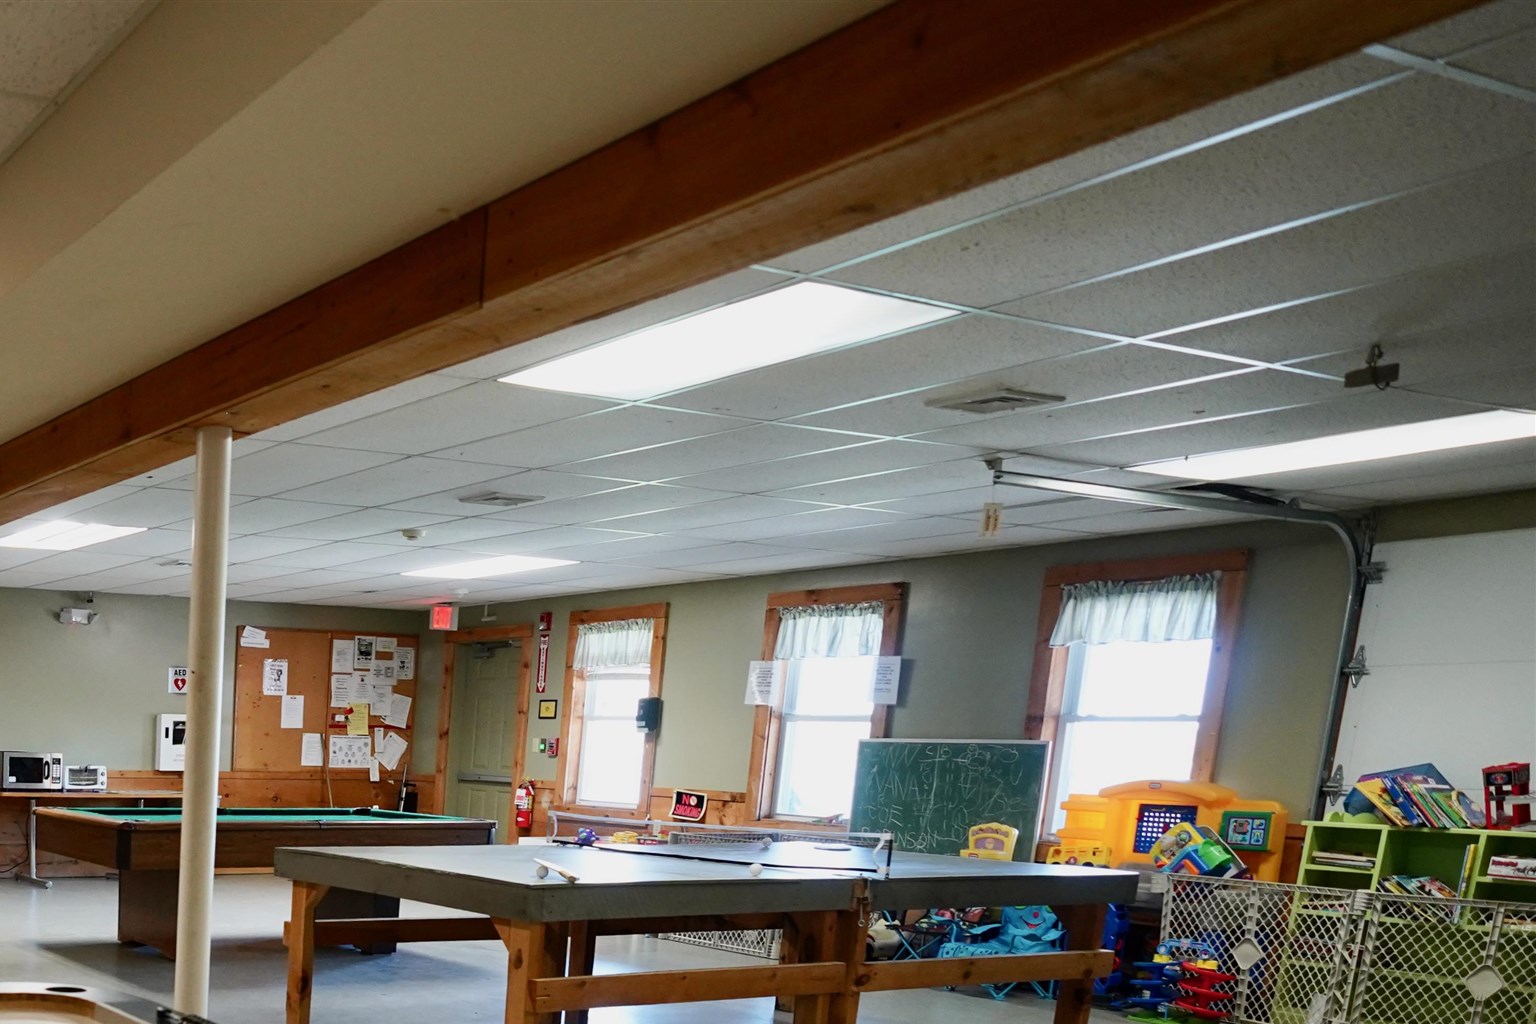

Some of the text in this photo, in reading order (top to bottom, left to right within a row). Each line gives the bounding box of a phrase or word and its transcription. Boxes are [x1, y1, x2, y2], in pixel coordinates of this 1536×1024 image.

[174, 668, 187, 676] AED
[681, 793, 698, 806] NO
[673, 804, 702, 818] SMOKING
